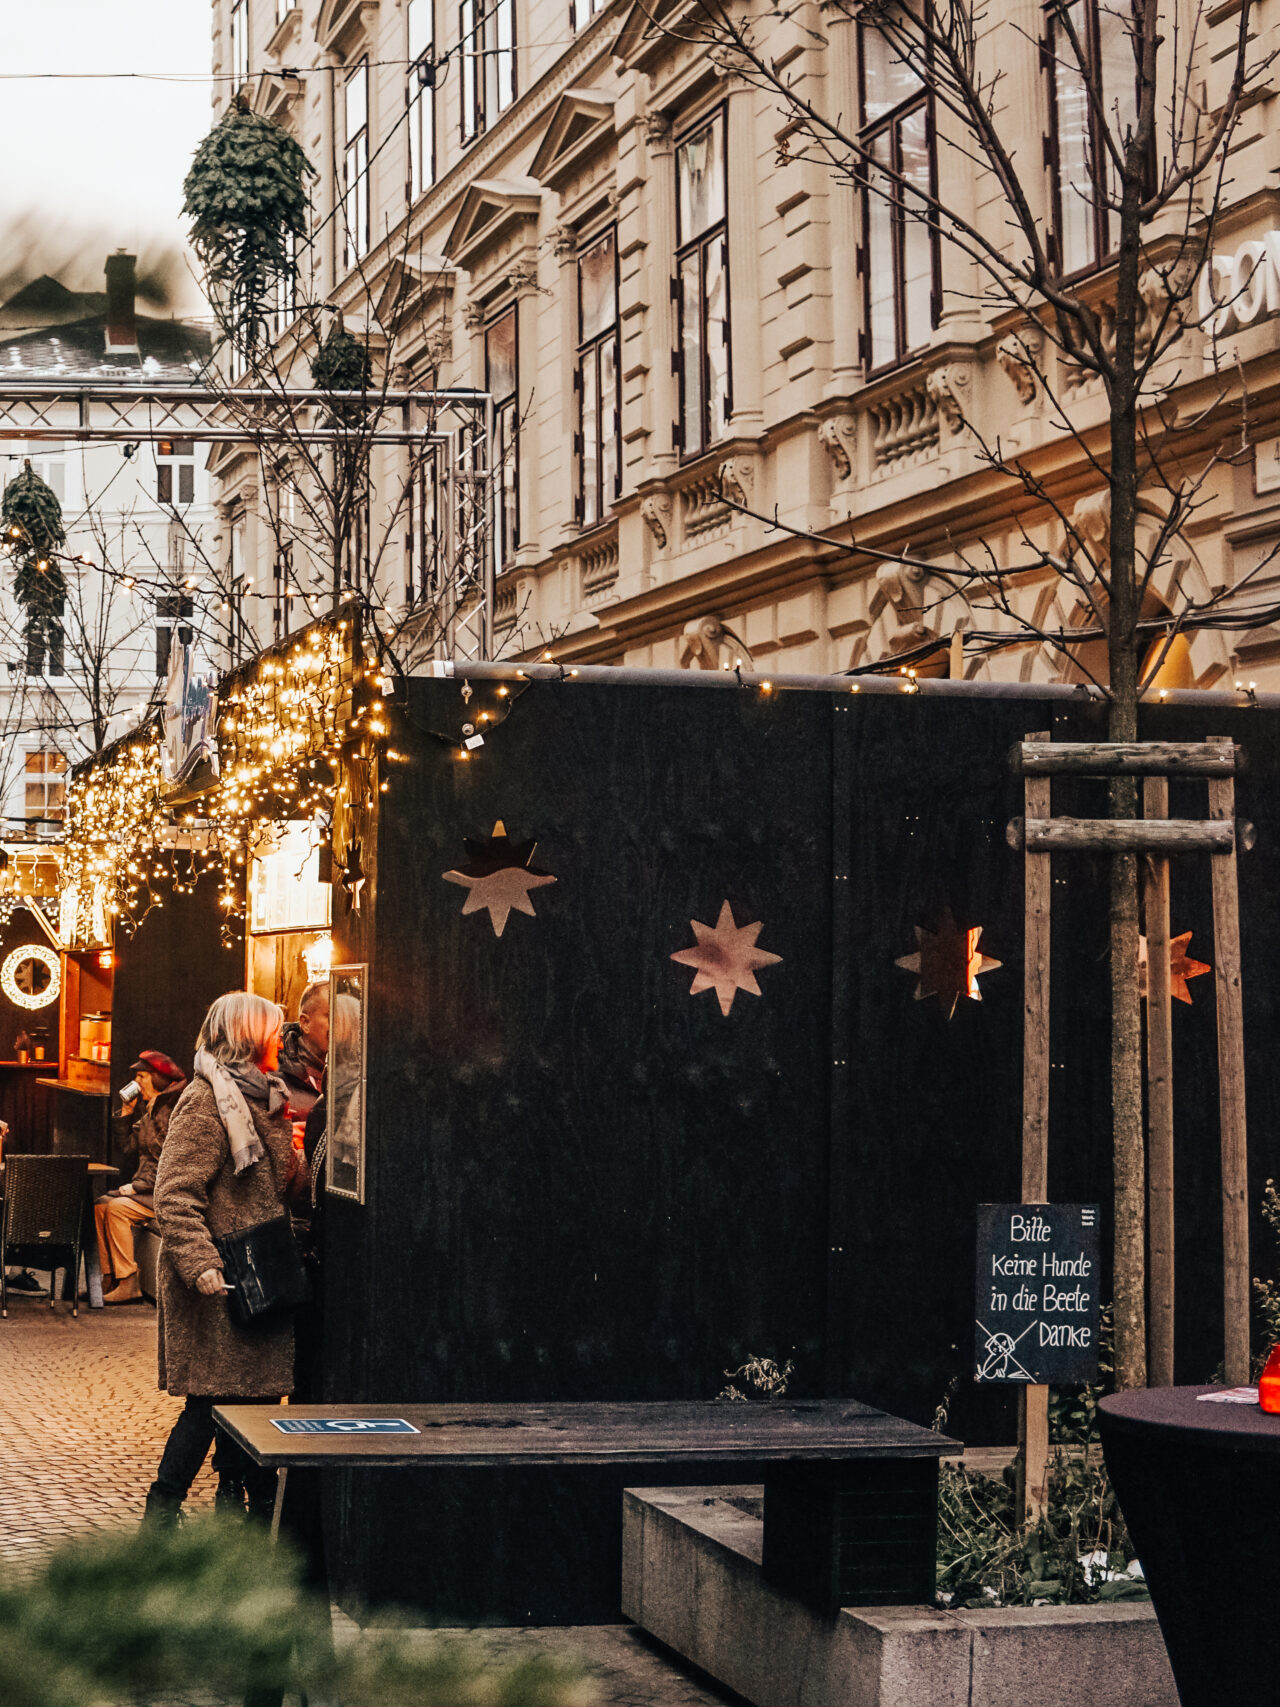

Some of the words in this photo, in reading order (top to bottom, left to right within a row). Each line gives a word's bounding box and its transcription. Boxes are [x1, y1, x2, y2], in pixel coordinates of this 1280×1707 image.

[1010, 1214, 1051, 1242] Bitte
[1042, 1251, 1092, 1277] Hunde
[990, 1285, 1008, 1312] in
[1012, 1283, 1038, 1312] die
[1043, 1283, 1090, 1313] Beete
[1039, 1321, 1091, 1348] Danke
